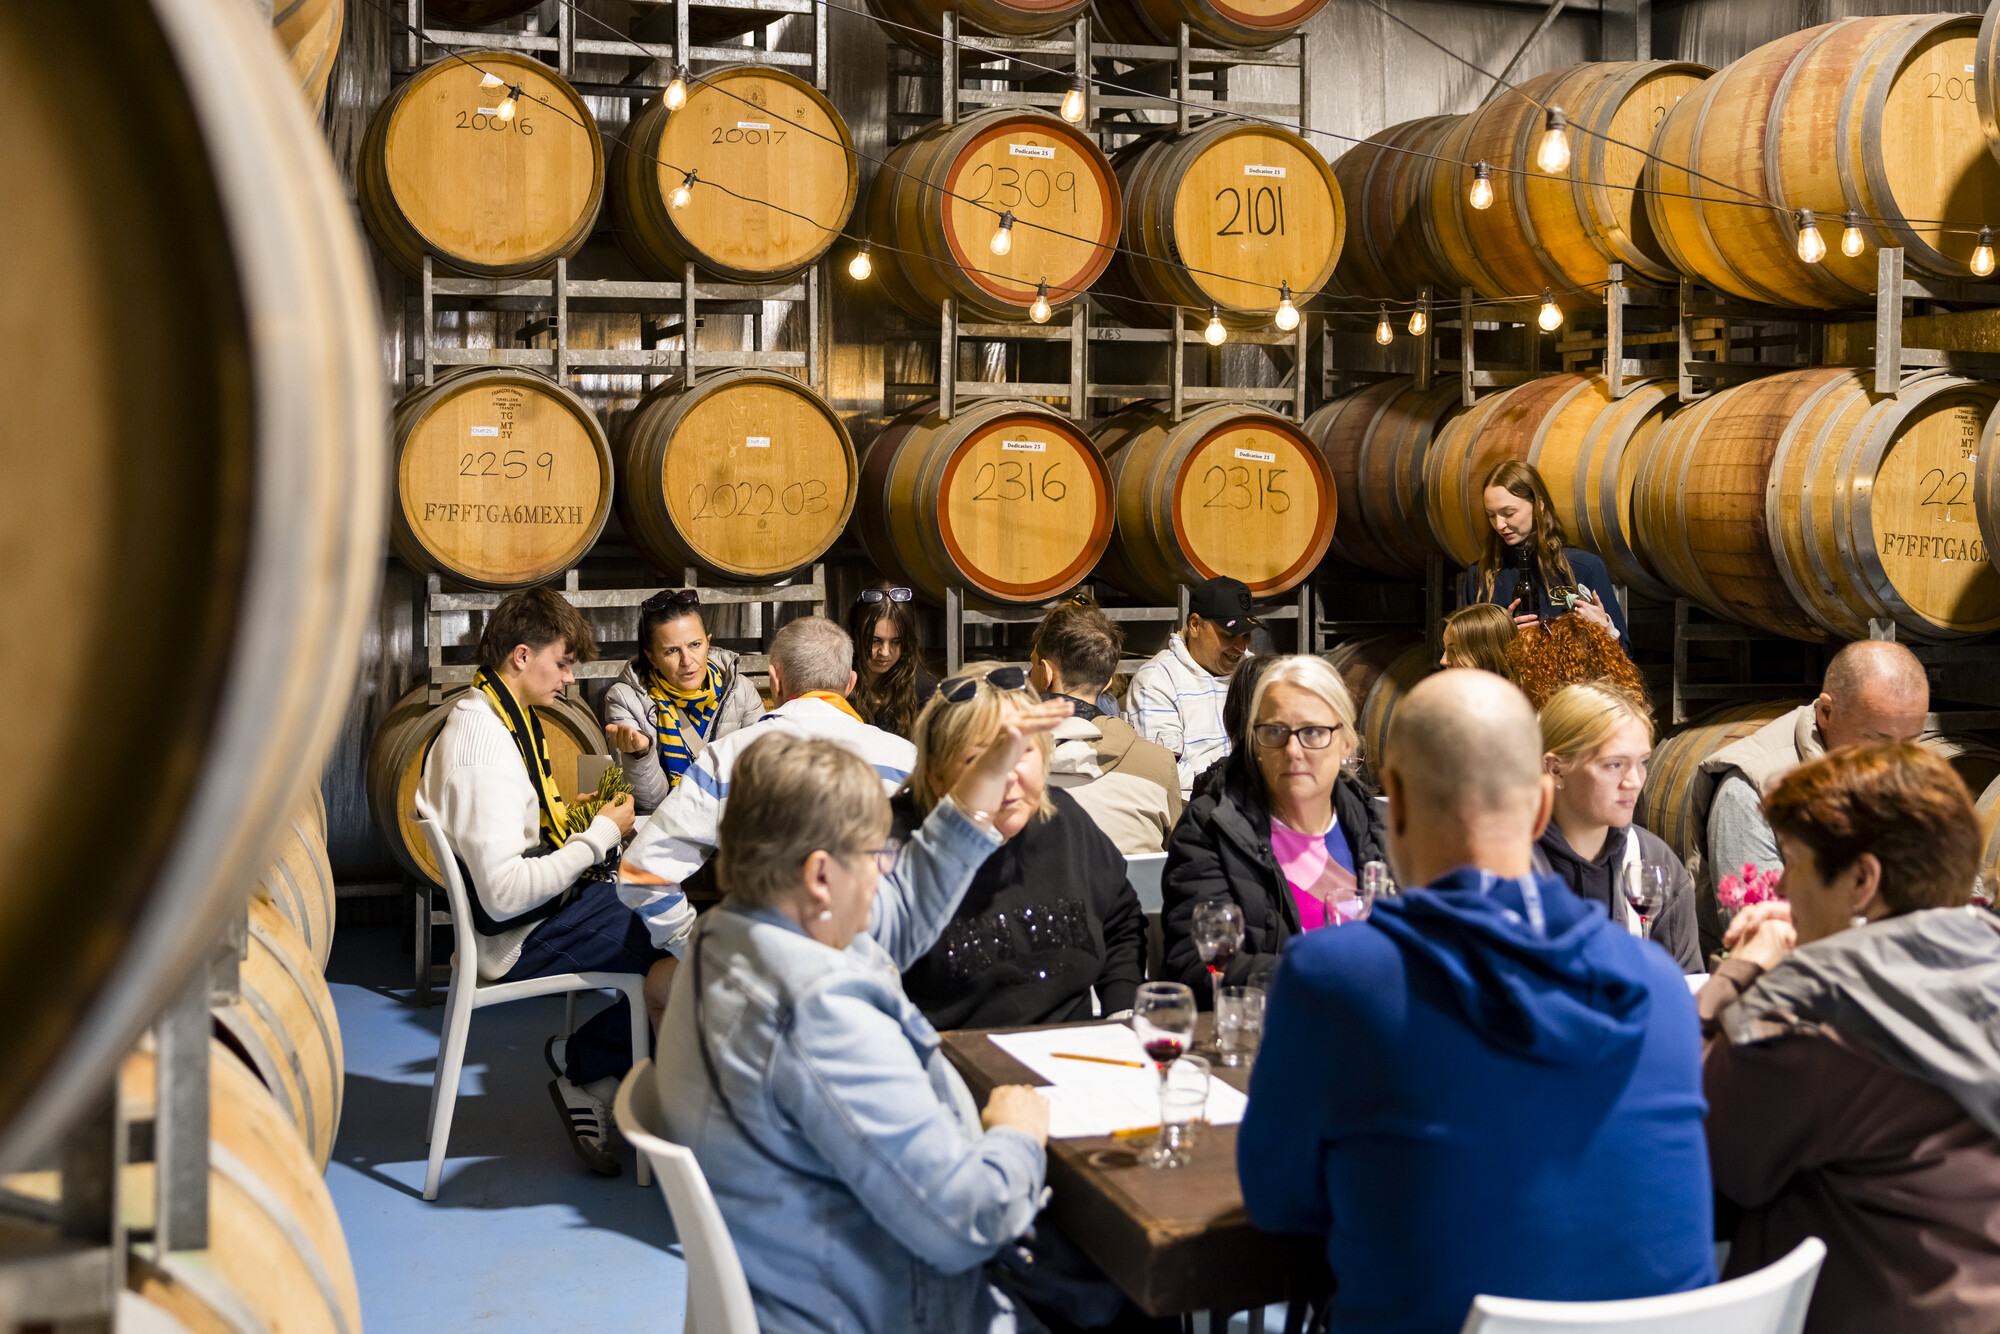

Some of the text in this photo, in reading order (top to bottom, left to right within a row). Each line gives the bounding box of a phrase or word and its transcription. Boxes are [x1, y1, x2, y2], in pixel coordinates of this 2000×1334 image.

[455, 110, 534, 136] 20016
[711, 126, 787, 145] 20017
[1014, 148, 1041, 156] Dedication
[1248, 167, 1273, 175] Dedication
[970, 163, 1077, 213] 2309
[1215, 186, 1285, 236] 2101
[1096, 328, 1122, 340] KIES
[500, 411, 513, 420] TG
[500, 421, 514, 430] MT
[501, 430, 513, 439] 3Y
[1961, 426, 1974, 437] TG
[1007, 442, 1033, 450] Dedication
[1960, 438, 1974, 448] MT
[1239, 451, 1263, 460] Dedication
[1961, 449, 1973, 459] 3Y
[459, 450, 553, 482] 2259
[972, 461, 1066, 502] 2316
[1203, 465, 1291, 514] 2315
[687, 479, 829, 521] 202203
[423, 502, 584, 525] F7FFTGA6MEXH
